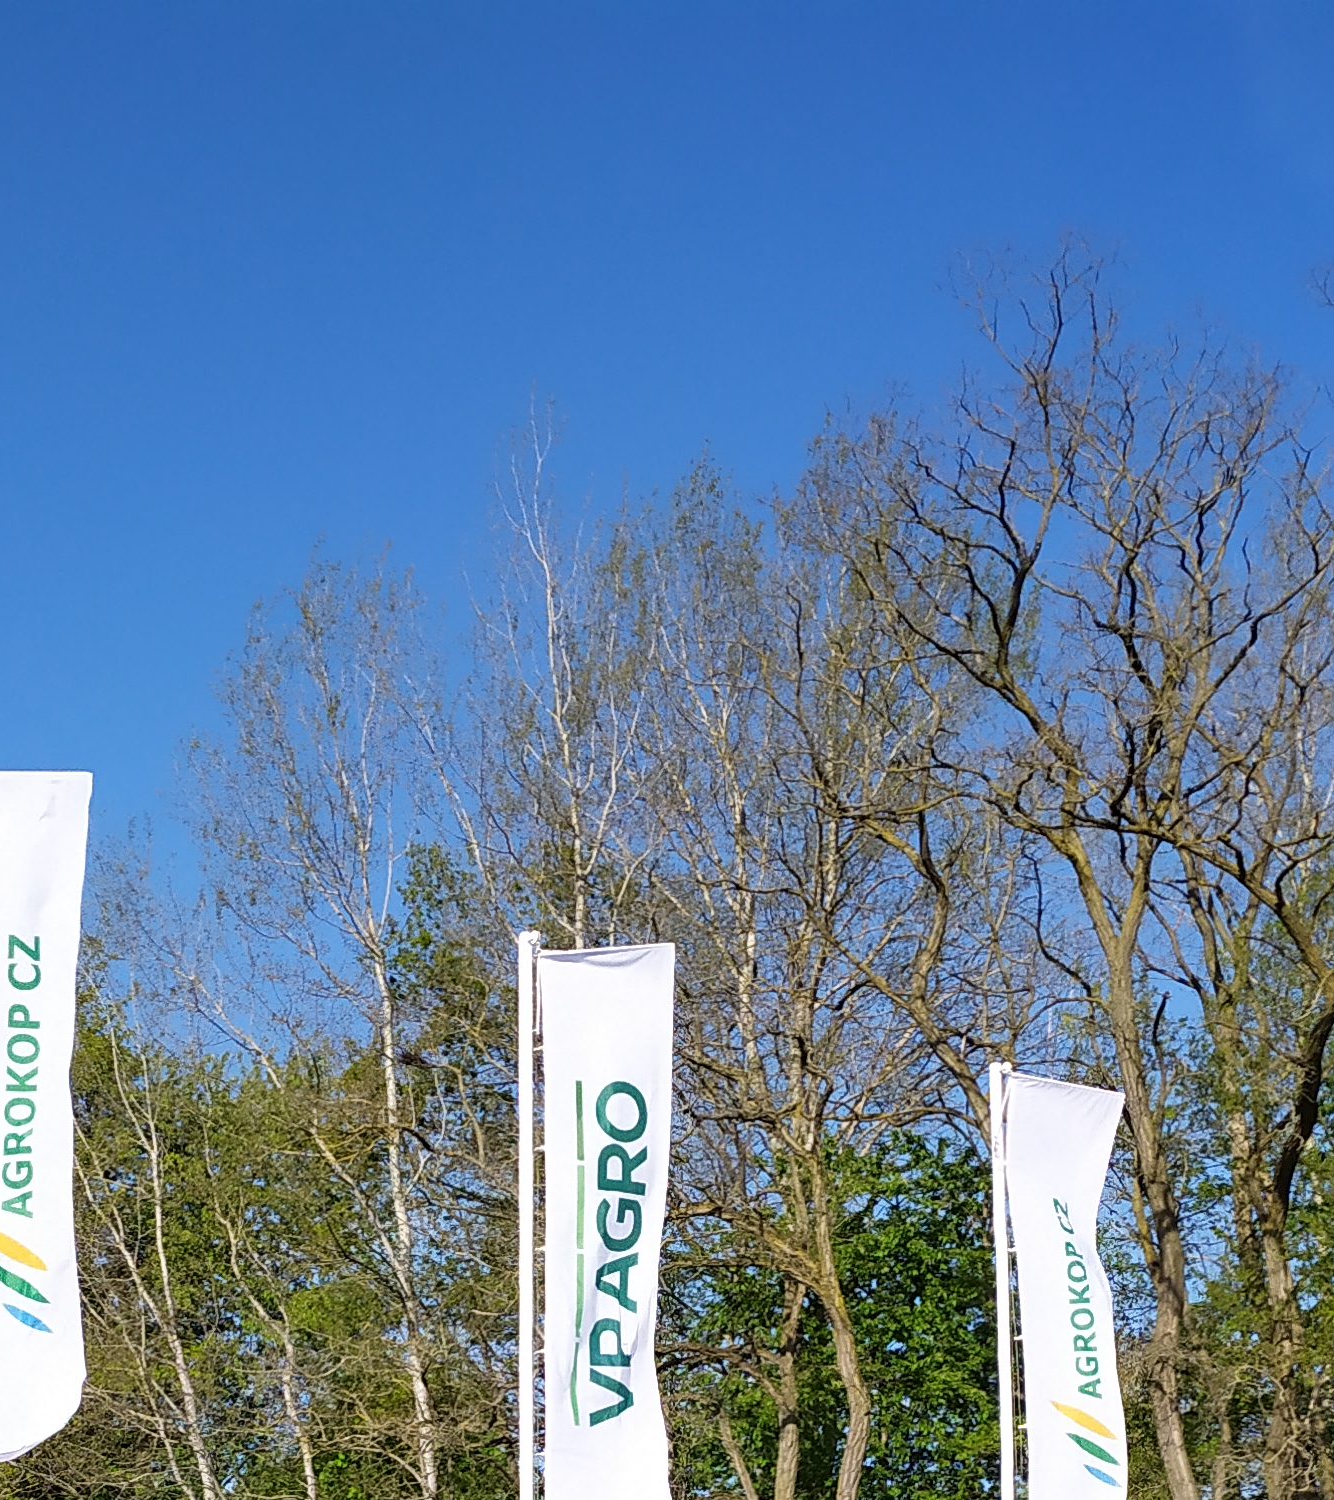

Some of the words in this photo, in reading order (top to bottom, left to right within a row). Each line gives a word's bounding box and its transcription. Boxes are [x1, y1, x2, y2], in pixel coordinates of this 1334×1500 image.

[7, 934, 42, 991] CZ
[1, 1003, 41, 1219] AGROKOP
[595, 1080, 648, 1314] AGRO
[1053, 1197, 1075, 1235] CZ
[589, 1317, 634, 1427] VP
[1065, 1241, 1102, 1399] AGROKOP
